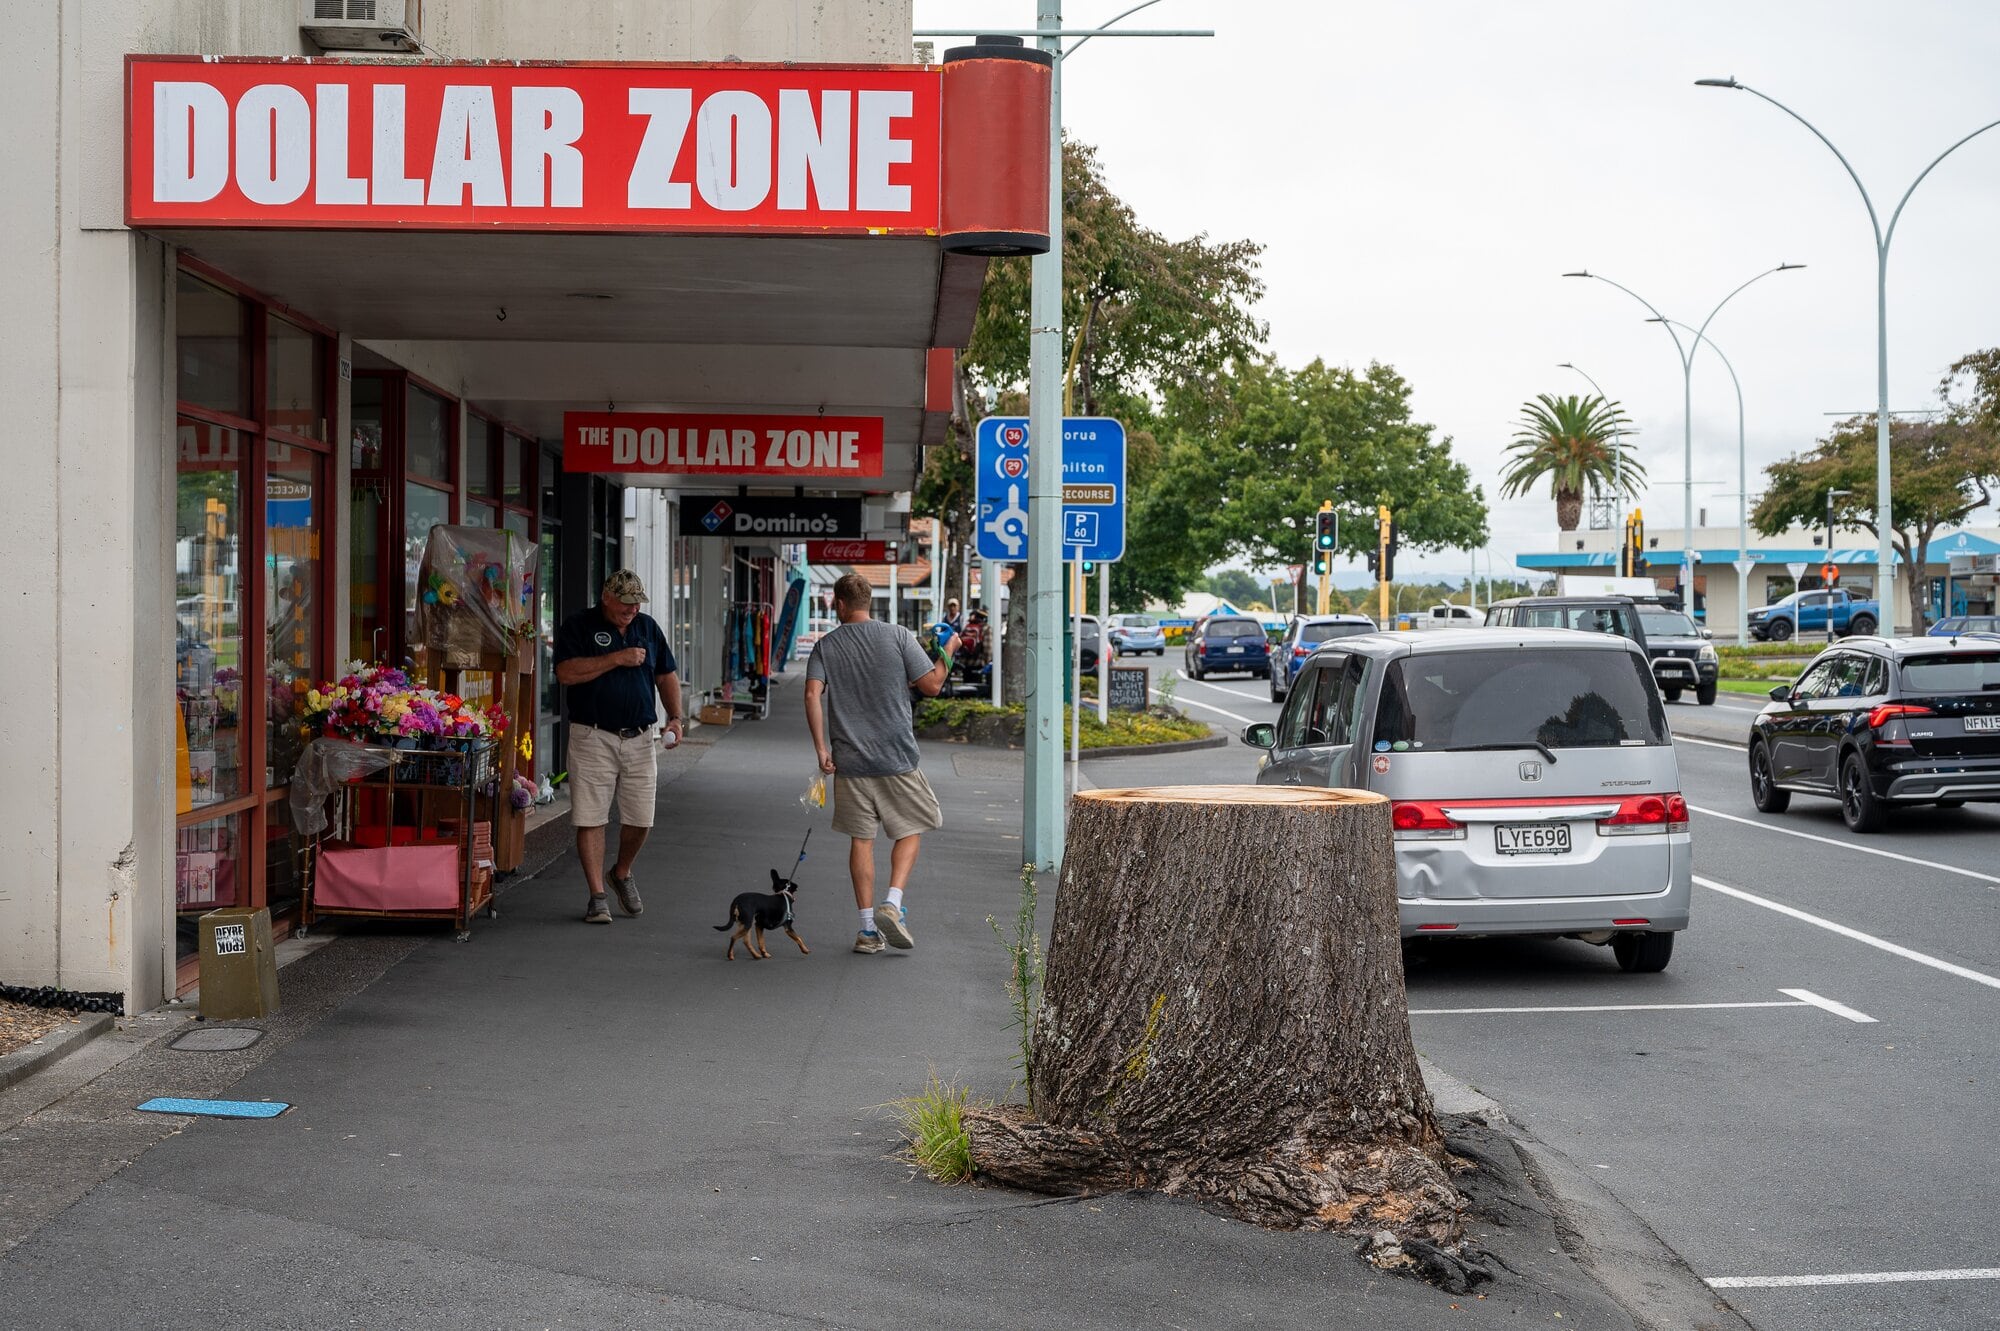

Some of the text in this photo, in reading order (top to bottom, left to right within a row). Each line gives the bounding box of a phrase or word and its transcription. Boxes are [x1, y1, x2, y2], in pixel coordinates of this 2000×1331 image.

[152, 81, 914, 212] DOLLAR ZONE
[1008, 431, 1020, 440] 36
[578, 427, 860, 468] THE DOLLAR ZONE
[1007, 462, 1020, 471] 29
[735, 512, 838, 533] Domino's
[1075, 514, 1087, 527] P
[1074, 528, 1087, 538] 60
[1111, 670, 1145, 681] INNER
[1115, 681, 1144, 690] LIGHT
[1499, 829, 1568, 848] LYE690
